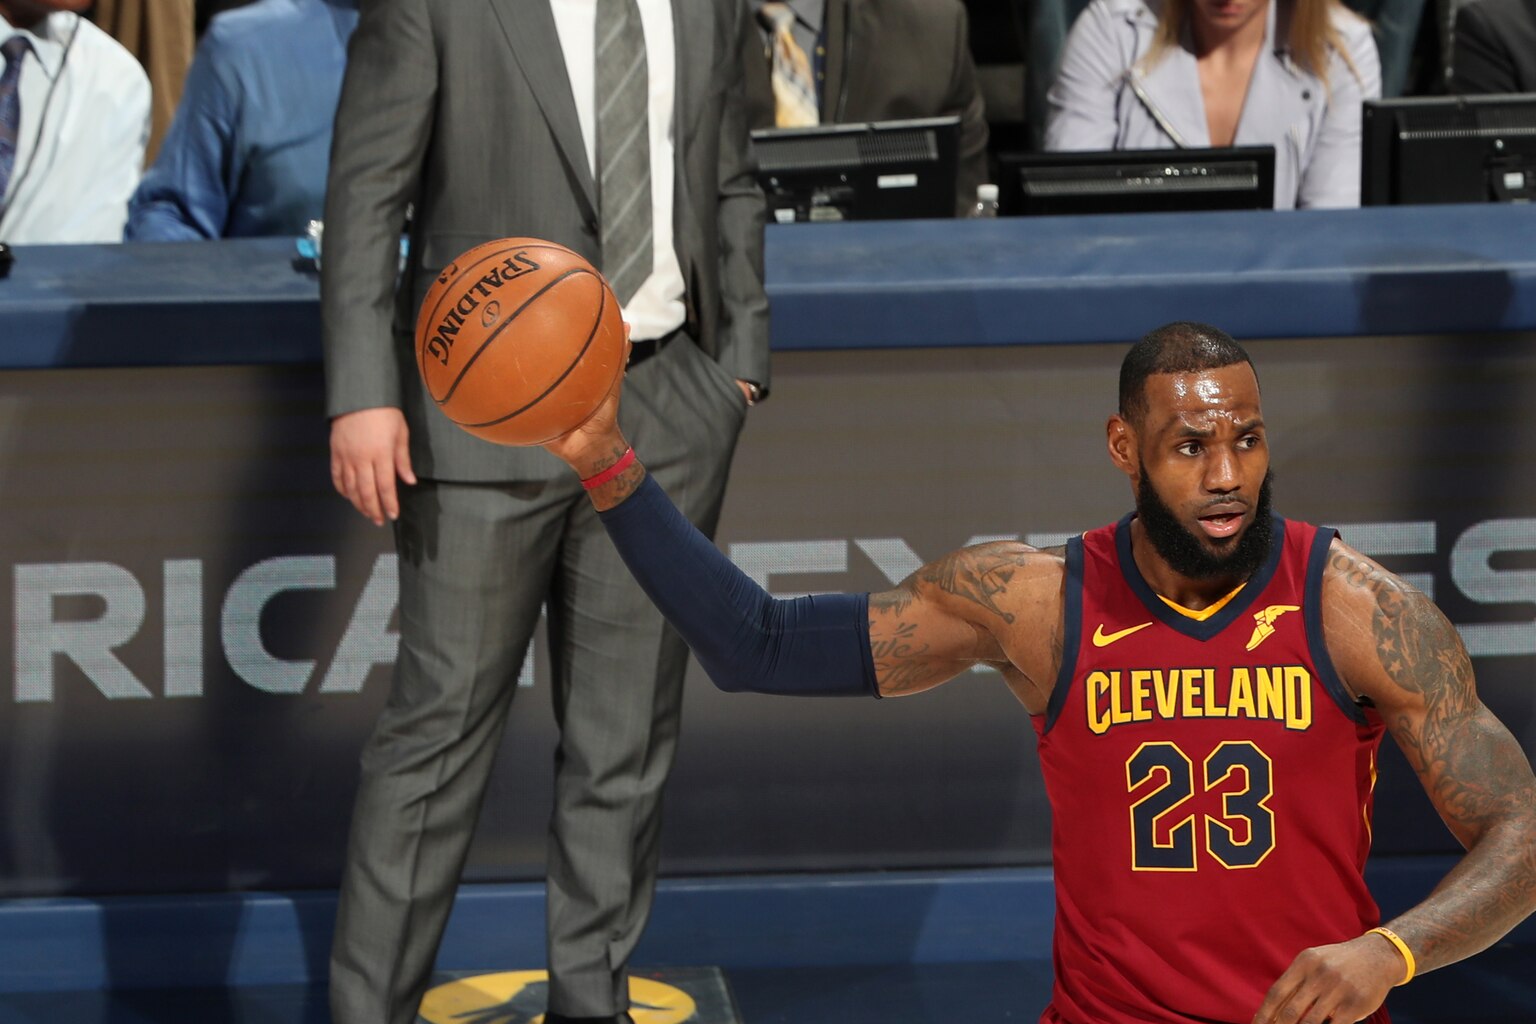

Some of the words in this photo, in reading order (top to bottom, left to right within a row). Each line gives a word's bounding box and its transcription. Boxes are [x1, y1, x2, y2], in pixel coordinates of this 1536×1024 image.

[428, 251, 541, 366] SPALDING
[1086, 665, 1312, 735] CLEVELAND
[1126, 741, 1275, 872] 23
